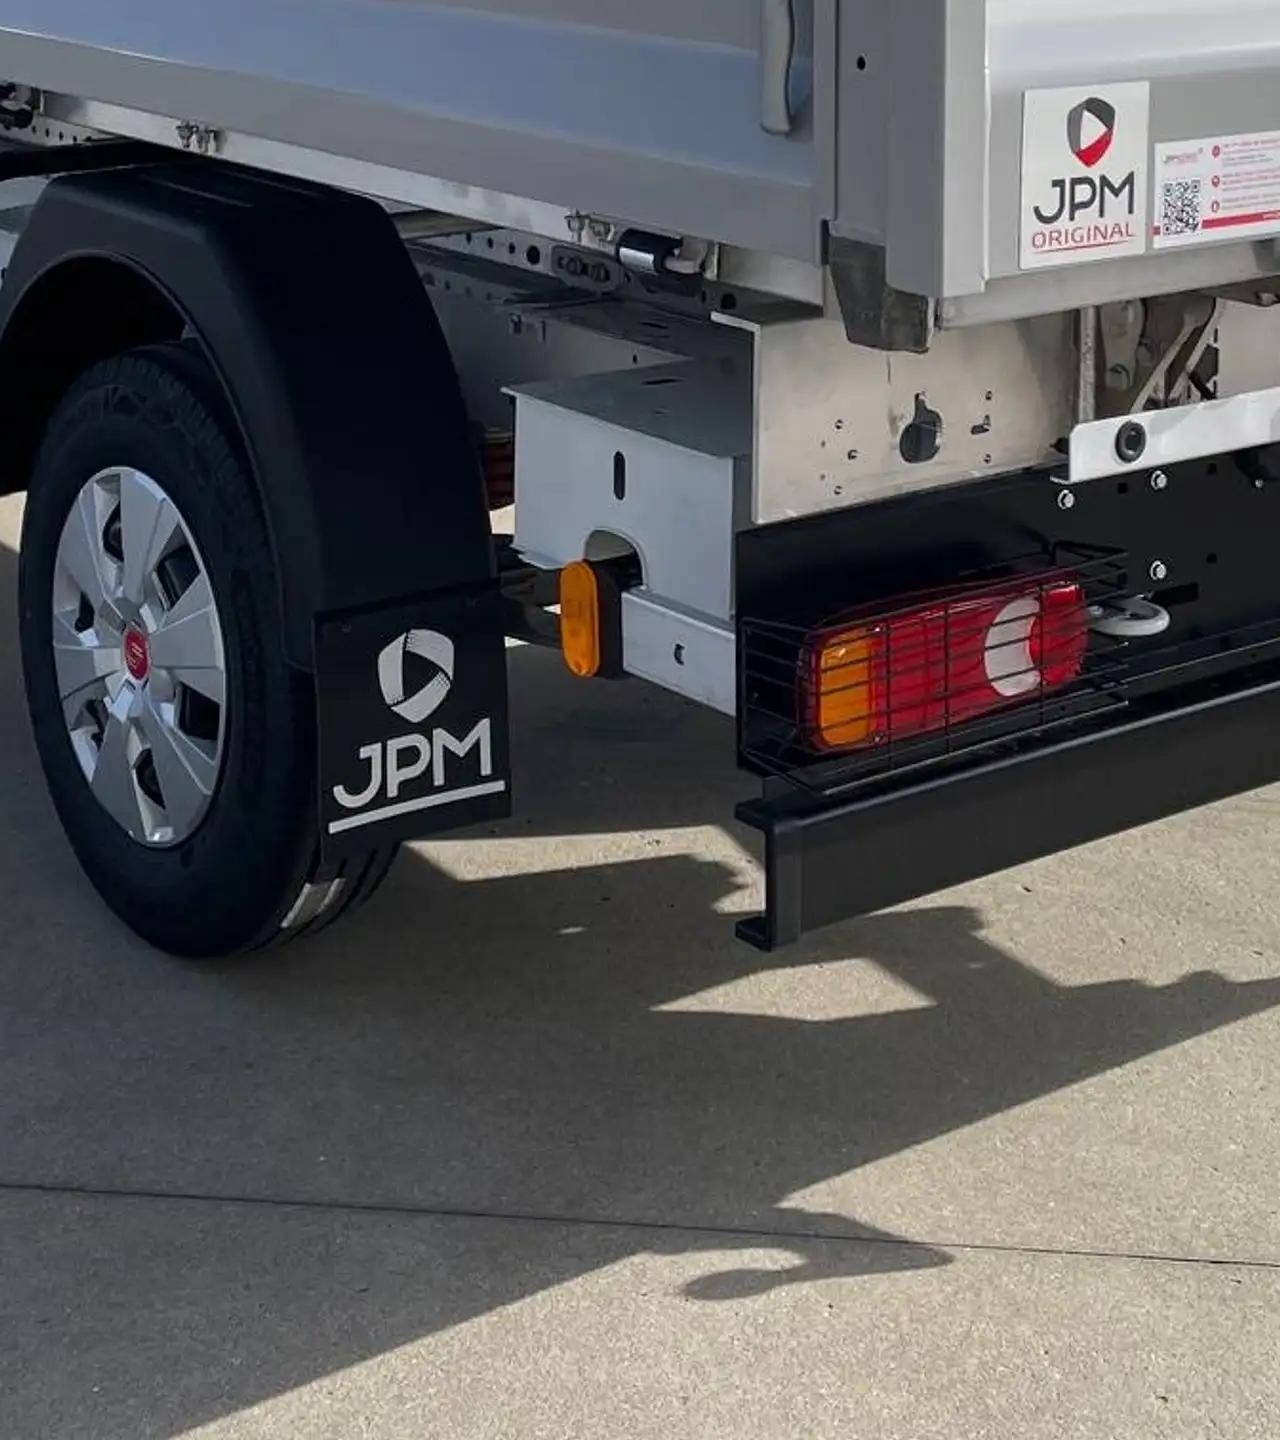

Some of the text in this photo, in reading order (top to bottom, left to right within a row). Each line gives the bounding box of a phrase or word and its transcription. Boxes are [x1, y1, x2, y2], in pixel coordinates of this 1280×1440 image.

[1033, 170, 1135, 225] JPM
[1031, 221, 1137, 248] ORIGINAL
[332, 717, 493, 809] JPM
